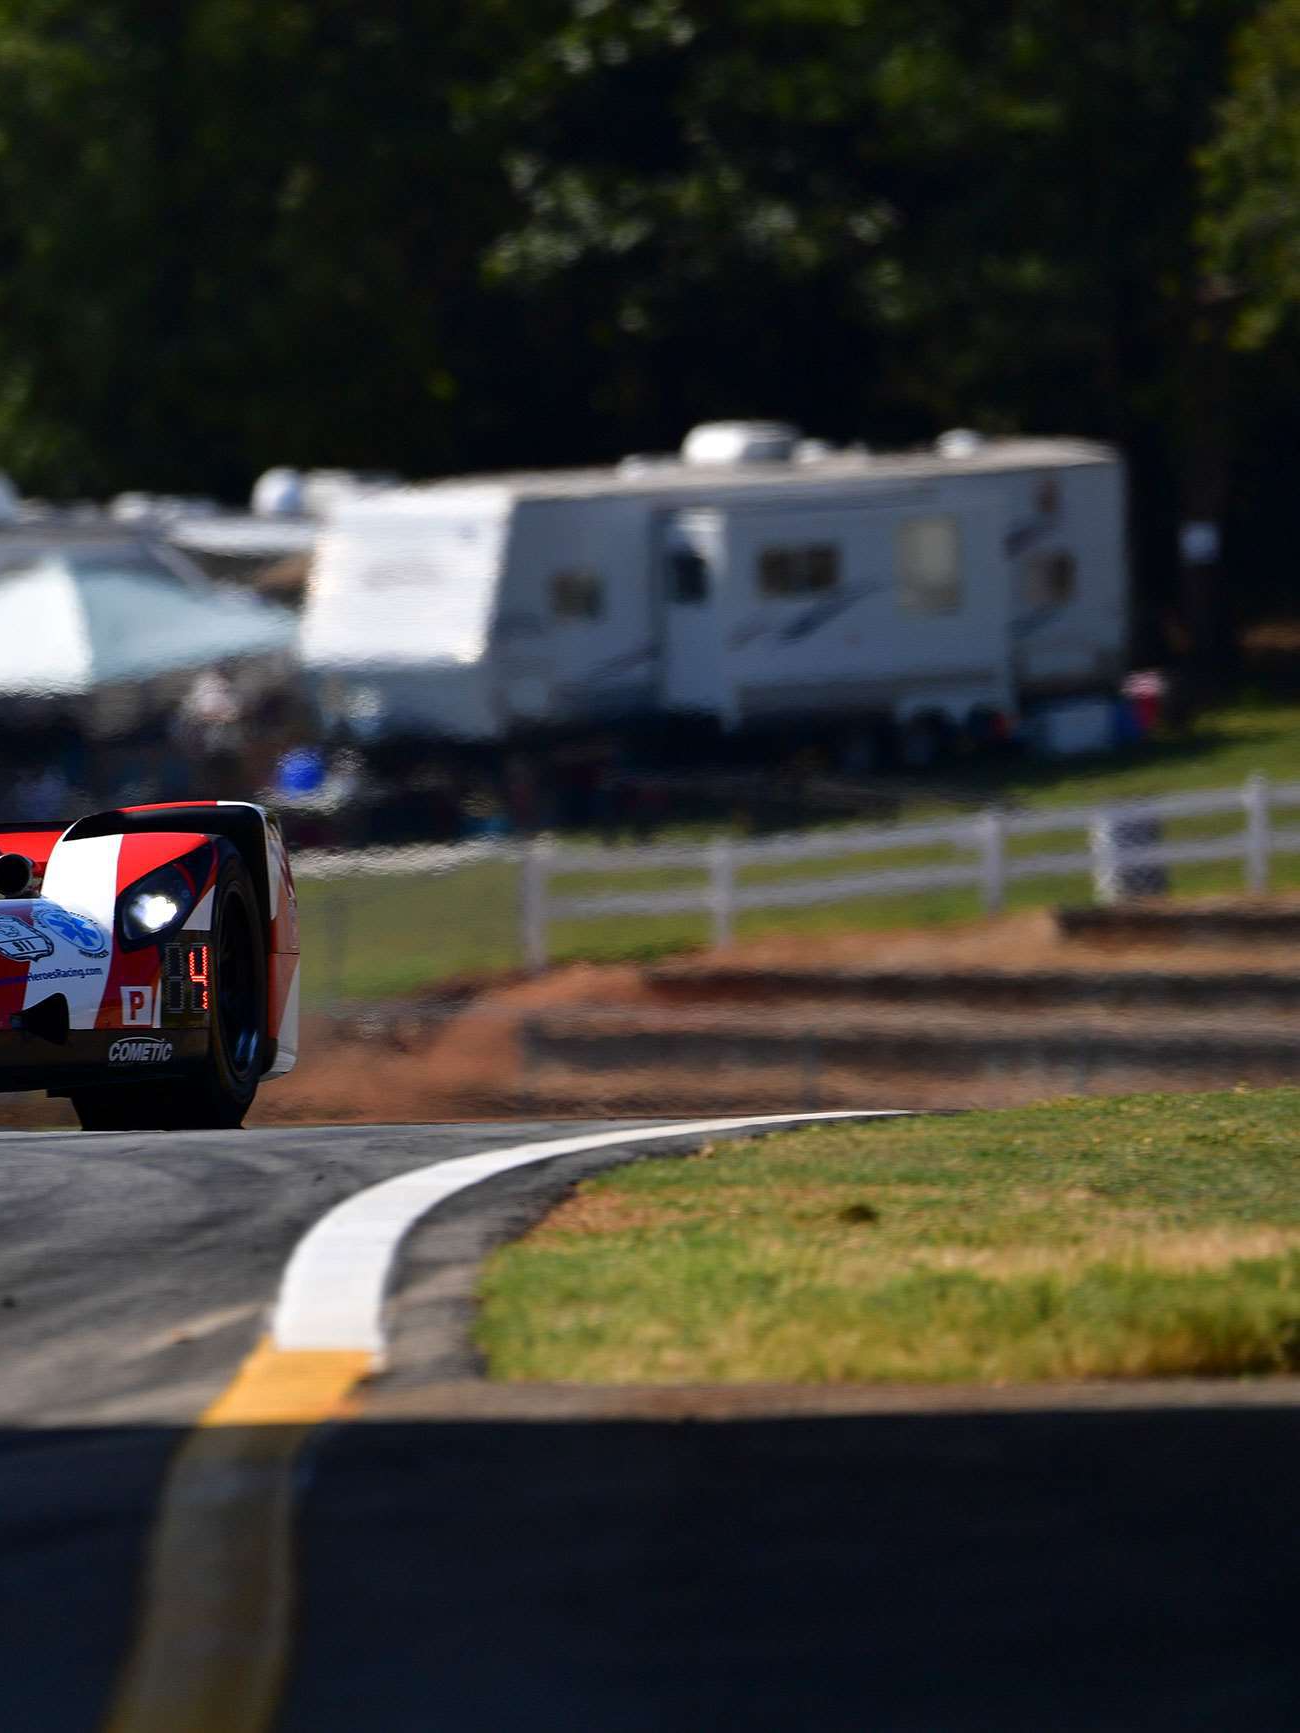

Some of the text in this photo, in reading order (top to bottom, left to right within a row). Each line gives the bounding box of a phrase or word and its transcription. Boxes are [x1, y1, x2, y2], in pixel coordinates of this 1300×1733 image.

[12, 940, 36, 953] 911
[188, 944, 209, 1010] 4
[128, 990, 146, 1021] P
[108, 1042, 173, 1062] COMETIC
